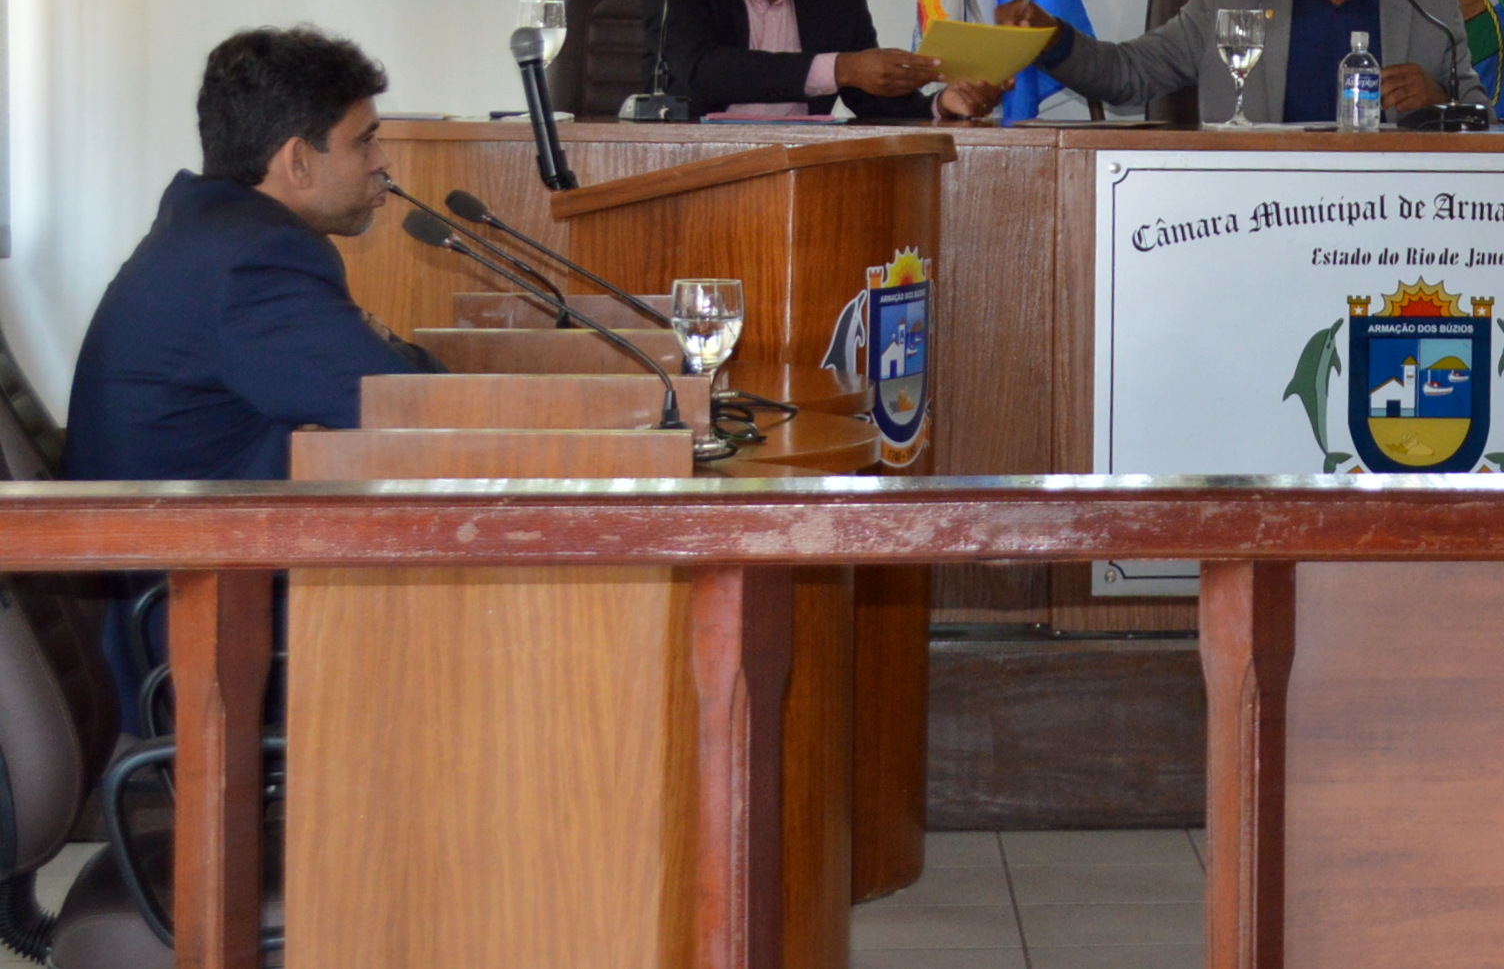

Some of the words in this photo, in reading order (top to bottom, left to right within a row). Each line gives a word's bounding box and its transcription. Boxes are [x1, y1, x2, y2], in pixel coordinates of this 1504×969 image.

[1132, 213, 1239, 252] Câmara
[1249, 194, 1388, 233] Municipal
[1399, 194, 1426, 221] de
[1311, 247, 1371, 266] Estado
[1378, 247, 1399, 266] do
[1405, 247, 1435, 266] Rio
[1438, 247, 1459, 266] de
[1368, 323, 1415, 334] ARMAÇÃO
[1417, 324, 1437, 333] DOS
[1439, 323, 1474, 334] BÚZIOS
